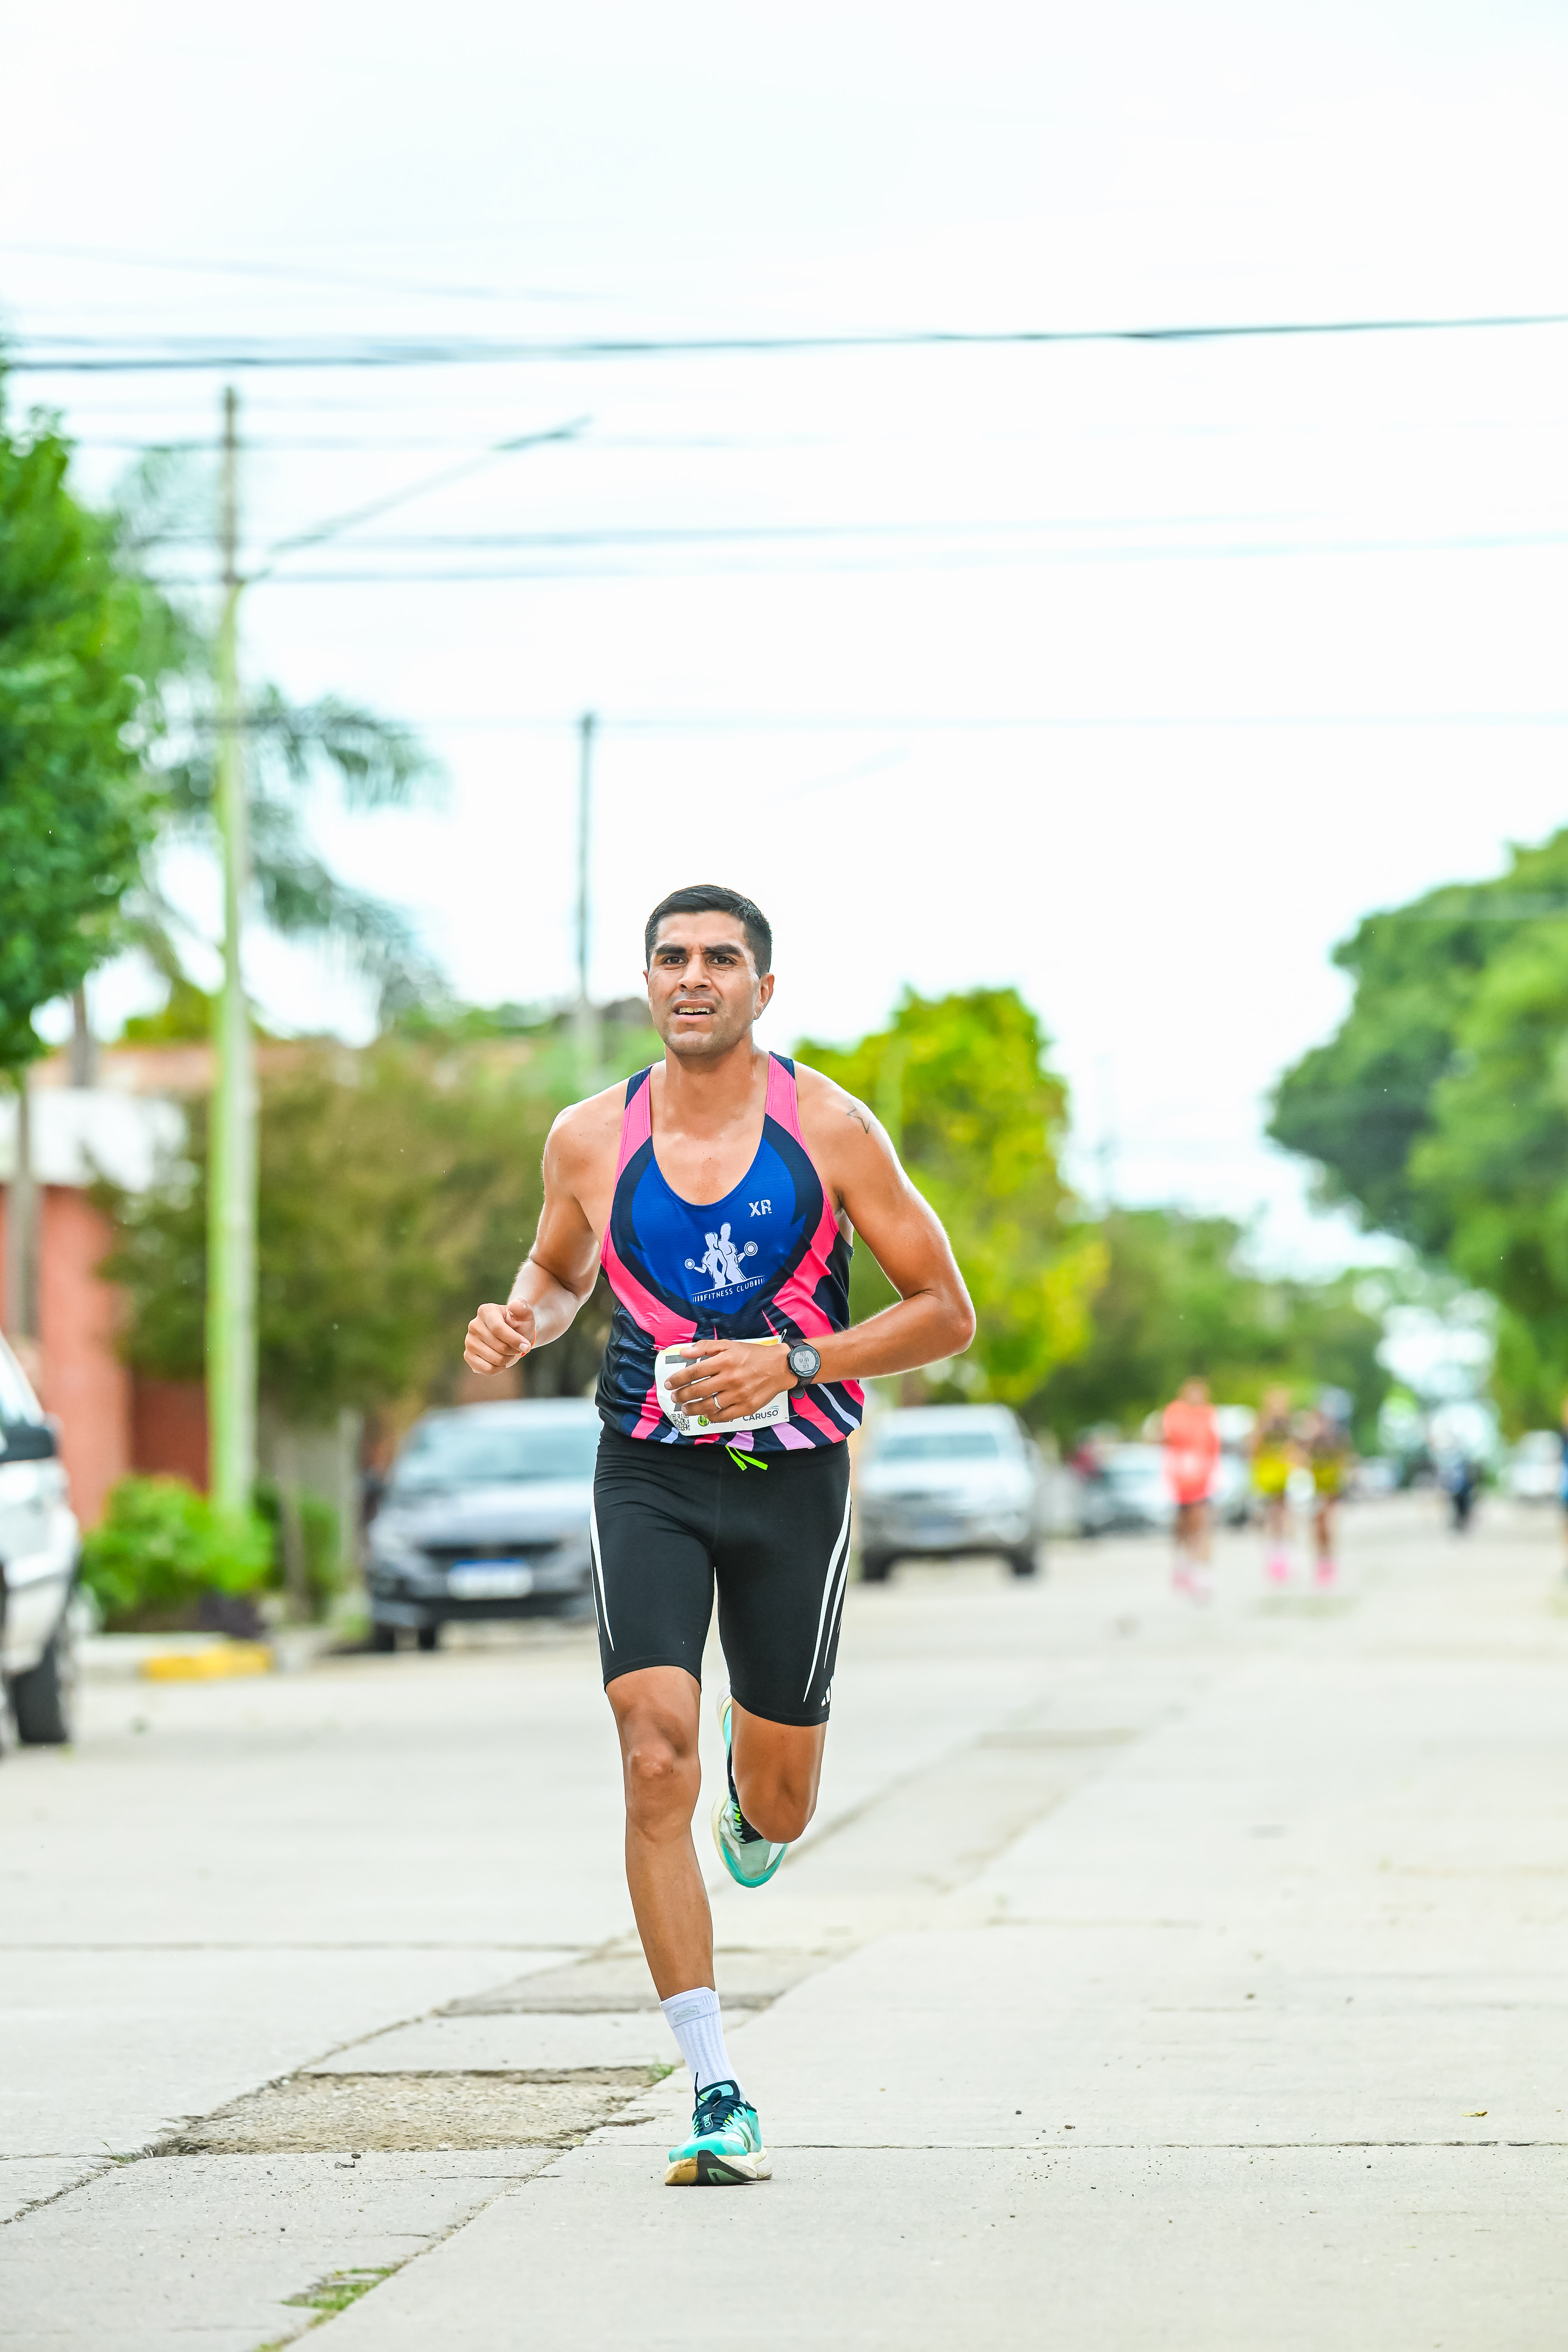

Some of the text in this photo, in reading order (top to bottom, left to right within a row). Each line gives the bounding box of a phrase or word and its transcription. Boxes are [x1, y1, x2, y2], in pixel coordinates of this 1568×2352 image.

[748, 1199, 772, 1217] XR
[704, 1281, 754, 1301] FITNESS CLUB
[743, 1410, 778, 1421] CARUSO
